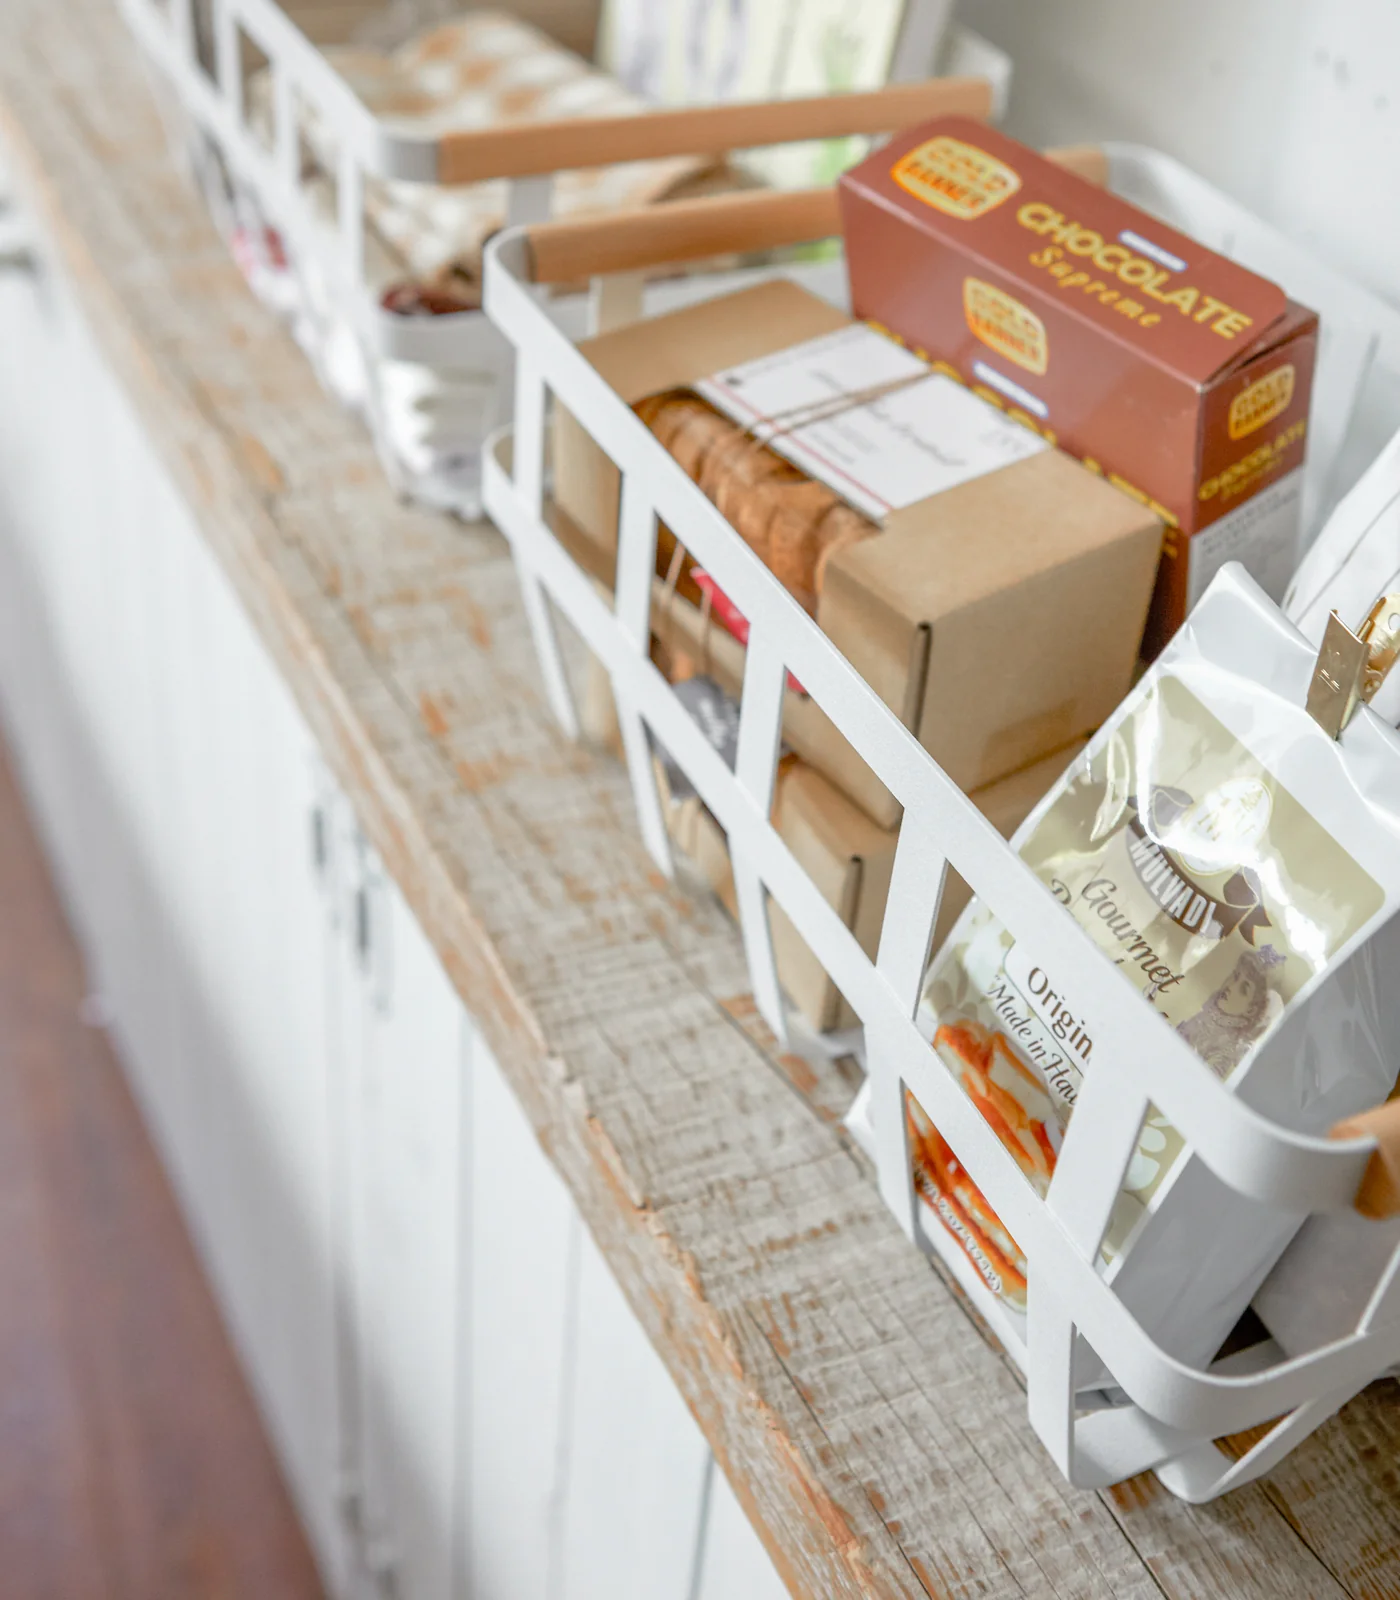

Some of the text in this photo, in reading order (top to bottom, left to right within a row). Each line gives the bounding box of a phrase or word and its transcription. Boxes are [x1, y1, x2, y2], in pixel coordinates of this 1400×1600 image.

[1016, 202, 1253, 339] CHOCOLATE
[1029, 245, 1162, 328] Supreme
[1129, 834, 1217, 934] MULVADI
[1081, 878, 1185, 993] Gourmet
[1028, 967, 1092, 1061] Origin
[1028, 1038, 1047, 1060] in
